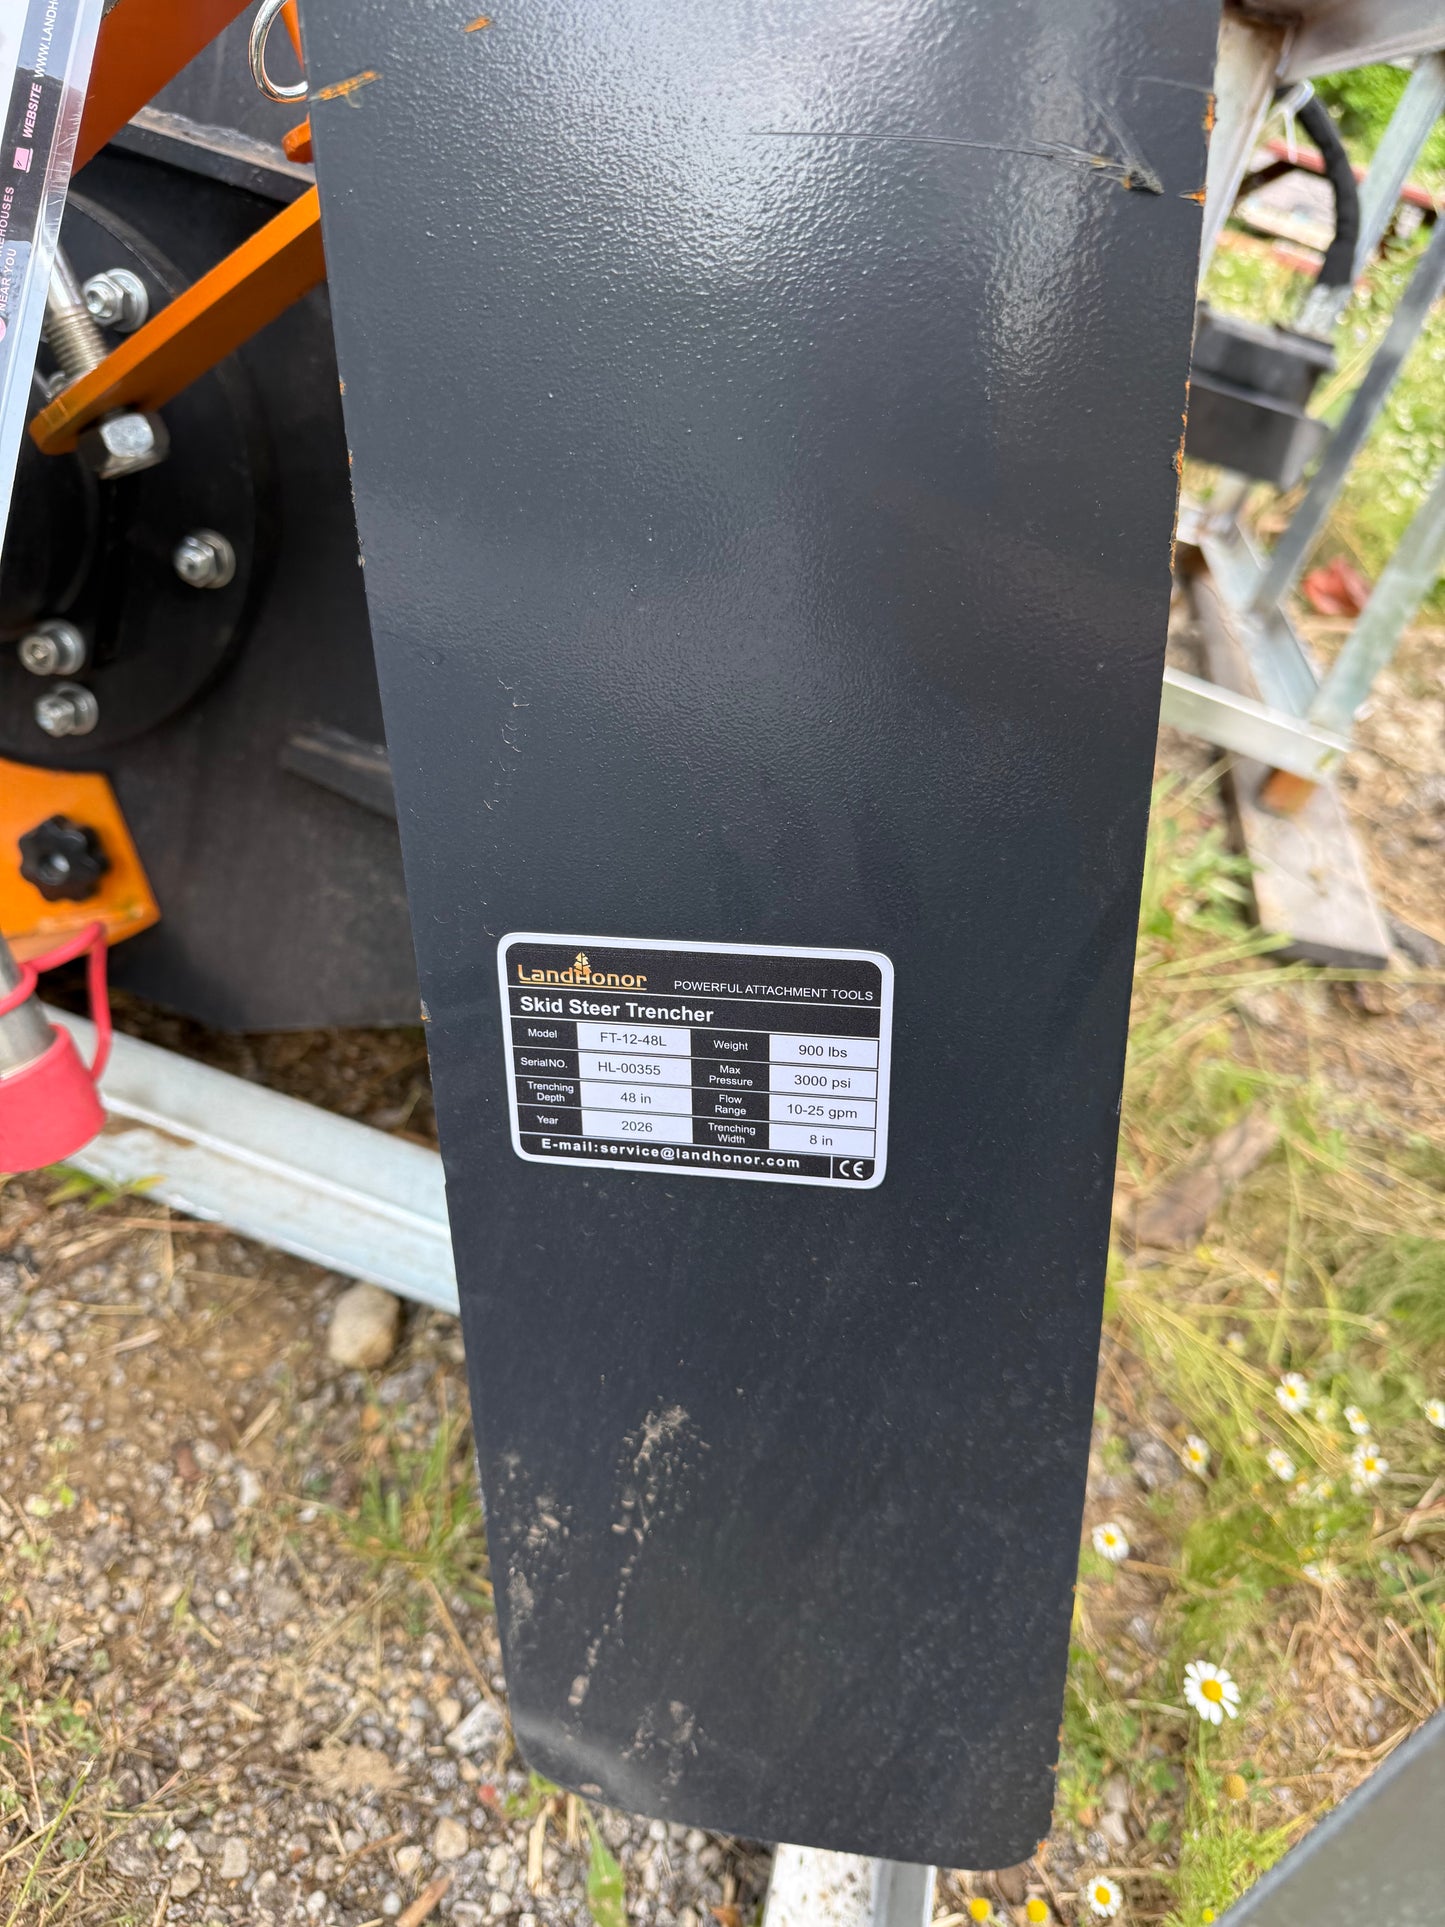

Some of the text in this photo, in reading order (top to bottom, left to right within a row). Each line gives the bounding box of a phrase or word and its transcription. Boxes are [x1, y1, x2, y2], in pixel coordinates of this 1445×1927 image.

[23, 0, 60, 139] WEBSITE WWW.LANDH
[0, 248, 17, 311] NEAR YOU
[517, 962, 648, 989] LandHonor
[674, 980, 873, 1001] POWERFUL ATTACHMENT TOOLS
[520, 996, 715, 1023] Skid Steer Trencher
[527, 1028, 558, 1039] Model
[600, 1031, 667, 1047] FT-12-48L
[713, 1039, 749, 1051] Weight
[798, 1044, 848, 1058] 900 lbs
[598, 1061, 661, 1076] HL-00355
[719, 1064, 741, 1075] Max
[527, 1081, 575, 1094] Trenching
[709, 1075, 753, 1087] Pressure
[794, 1074, 851, 1090] 3000 psi
[536, 1092, 565, 1103] Depth
[620, 1091, 652, 1104] 48 in
[718, 1094, 742, 1104] Flow
[714, 1104, 747, 1116] Range
[787, 1103, 858, 1120] 10-25 gpm
[537, 1115, 559, 1125] Year
[621, 1120, 653, 1133] 2026
[708, 1122, 756, 1135] Trenching
[717, 1133, 746, 1145] Width
[809, 1134, 833, 1147] 8 in
[541, 1137, 800, 1169] E-mail:service@landhonor.com
